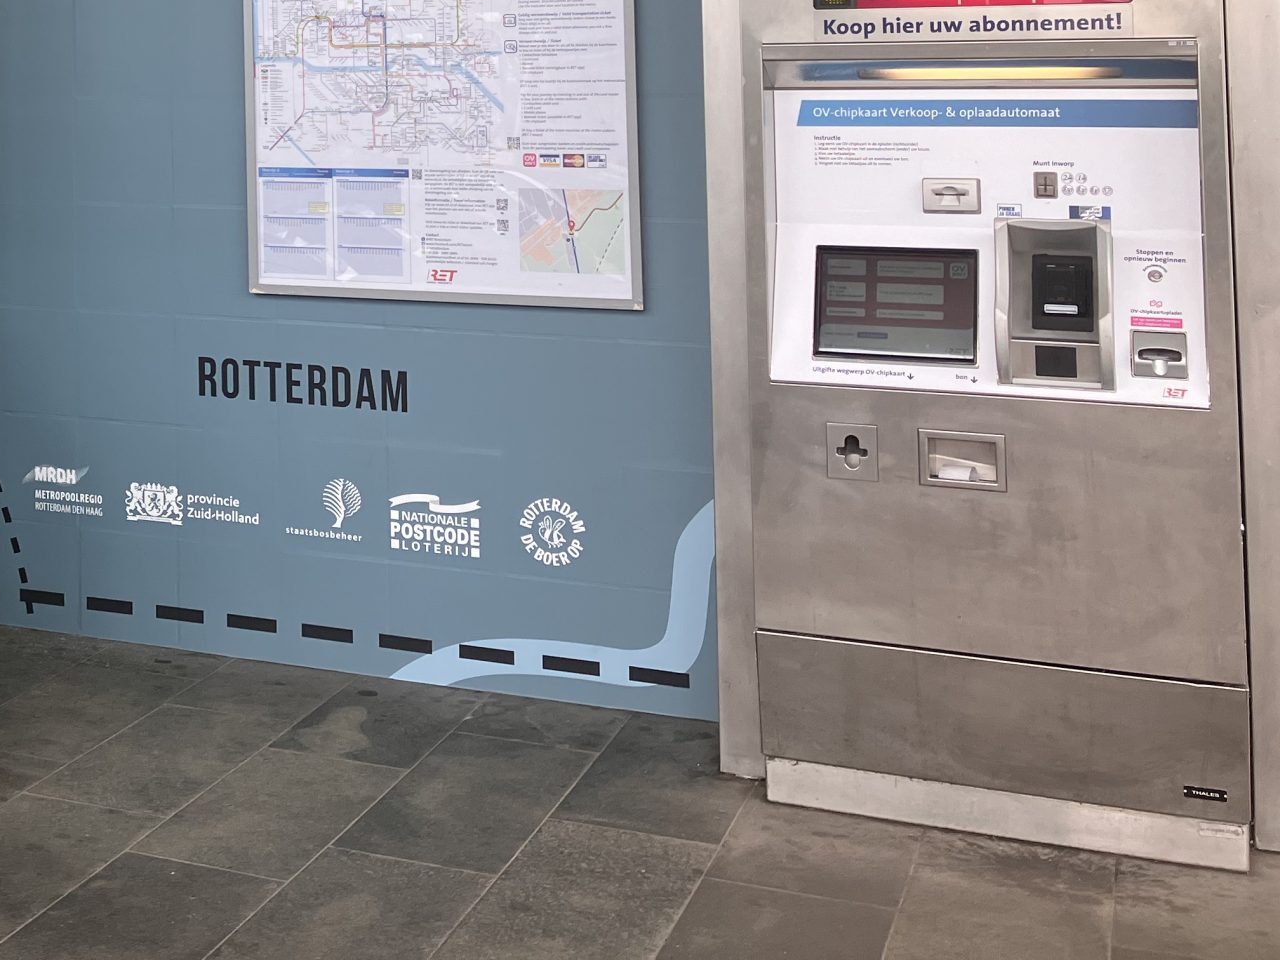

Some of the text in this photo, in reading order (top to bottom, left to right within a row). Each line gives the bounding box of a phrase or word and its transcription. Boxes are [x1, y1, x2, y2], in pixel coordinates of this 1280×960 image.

[823, 12, 1122, 39] Koop hier uw abonnement!
[813, 106, 1060, 120] OV-chipkaart Verkoop- & oplaadautomaat
[1136, 248, 1164, 256] Stoppen
[430, 269, 458, 282] RET
[198, 356, 408, 413] ROTTERDAM
[34, 466, 76, 485] MRDH
[35, 490, 103, 504] METROPOOLREGIO
[187, 493, 240, 508] provincie
[35, 502, 103, 517] ROTTERDAM DEN HAAG
[187, 508, 260, 525] Zuid-Holland
[520, 498, 586, 534] ROTTERDAM
[401, 511, 468, 527] NATIONALE
[286, 526, 363, 542] staatsbosbeheer
[390, 522, 480, 547] POSTCODE
[401, 540, 469, 557] LOTERIJ
[520, 534, 585, 567] DE BOER OP
